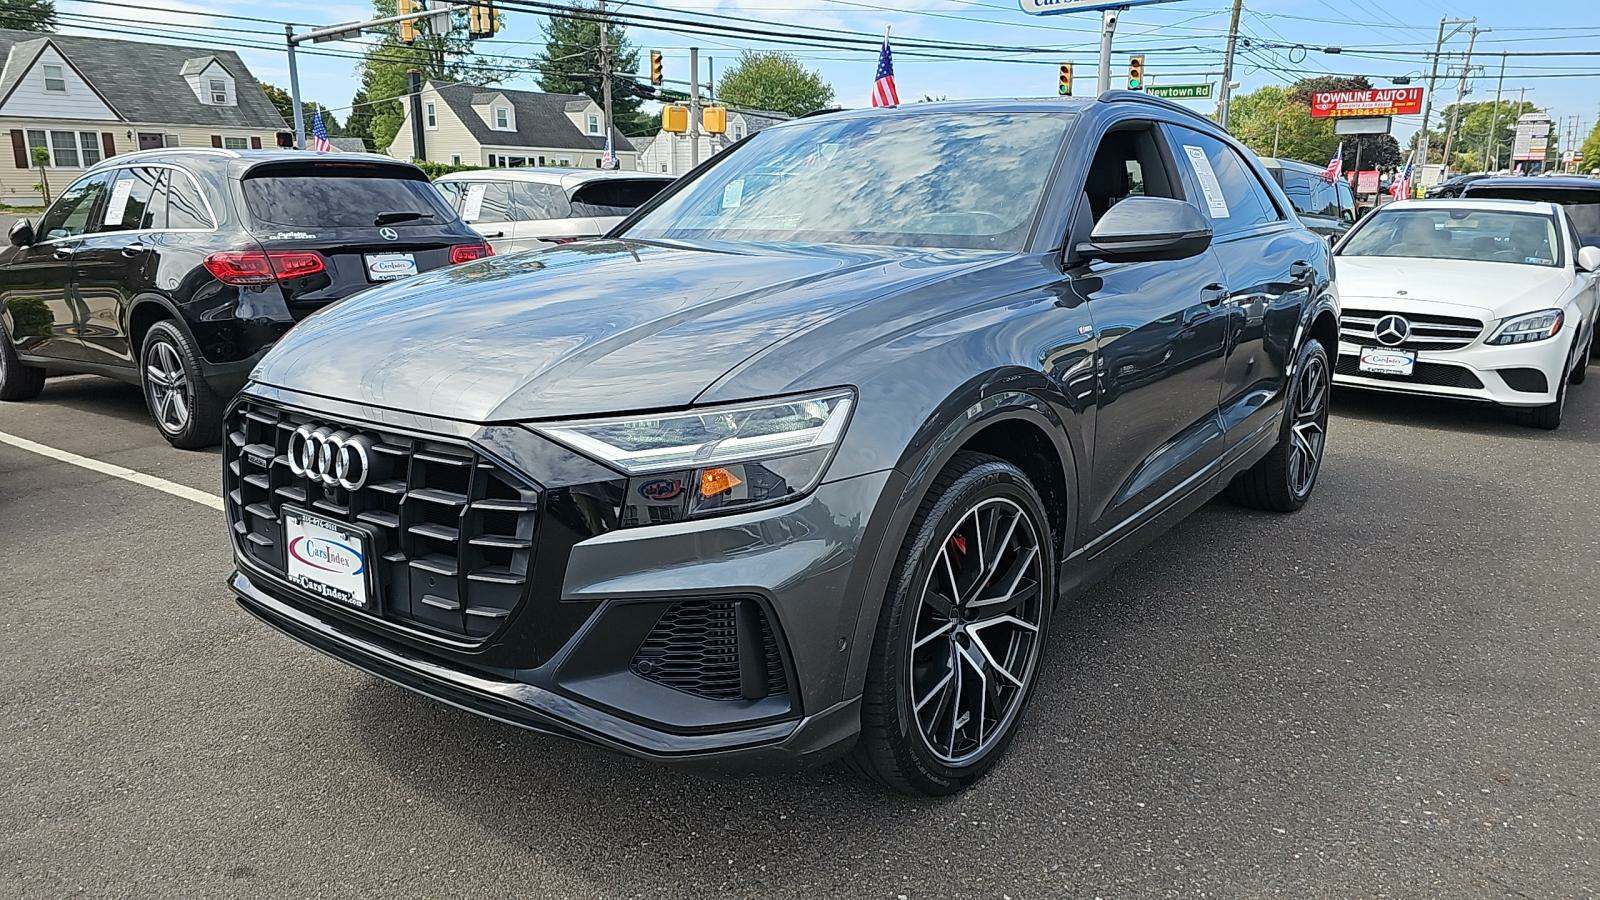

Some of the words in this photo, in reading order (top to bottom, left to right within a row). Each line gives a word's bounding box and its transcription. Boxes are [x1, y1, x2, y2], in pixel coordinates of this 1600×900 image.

[1147, 87, 1193, 97] Newtown
[1195, 86, 1209, 96] Rd
[1315, 91, 1372, 103] TOWNLINE
[1375, 90, 1407, 101] AUTO
[306, 539, 350, 568] CarsIndex
